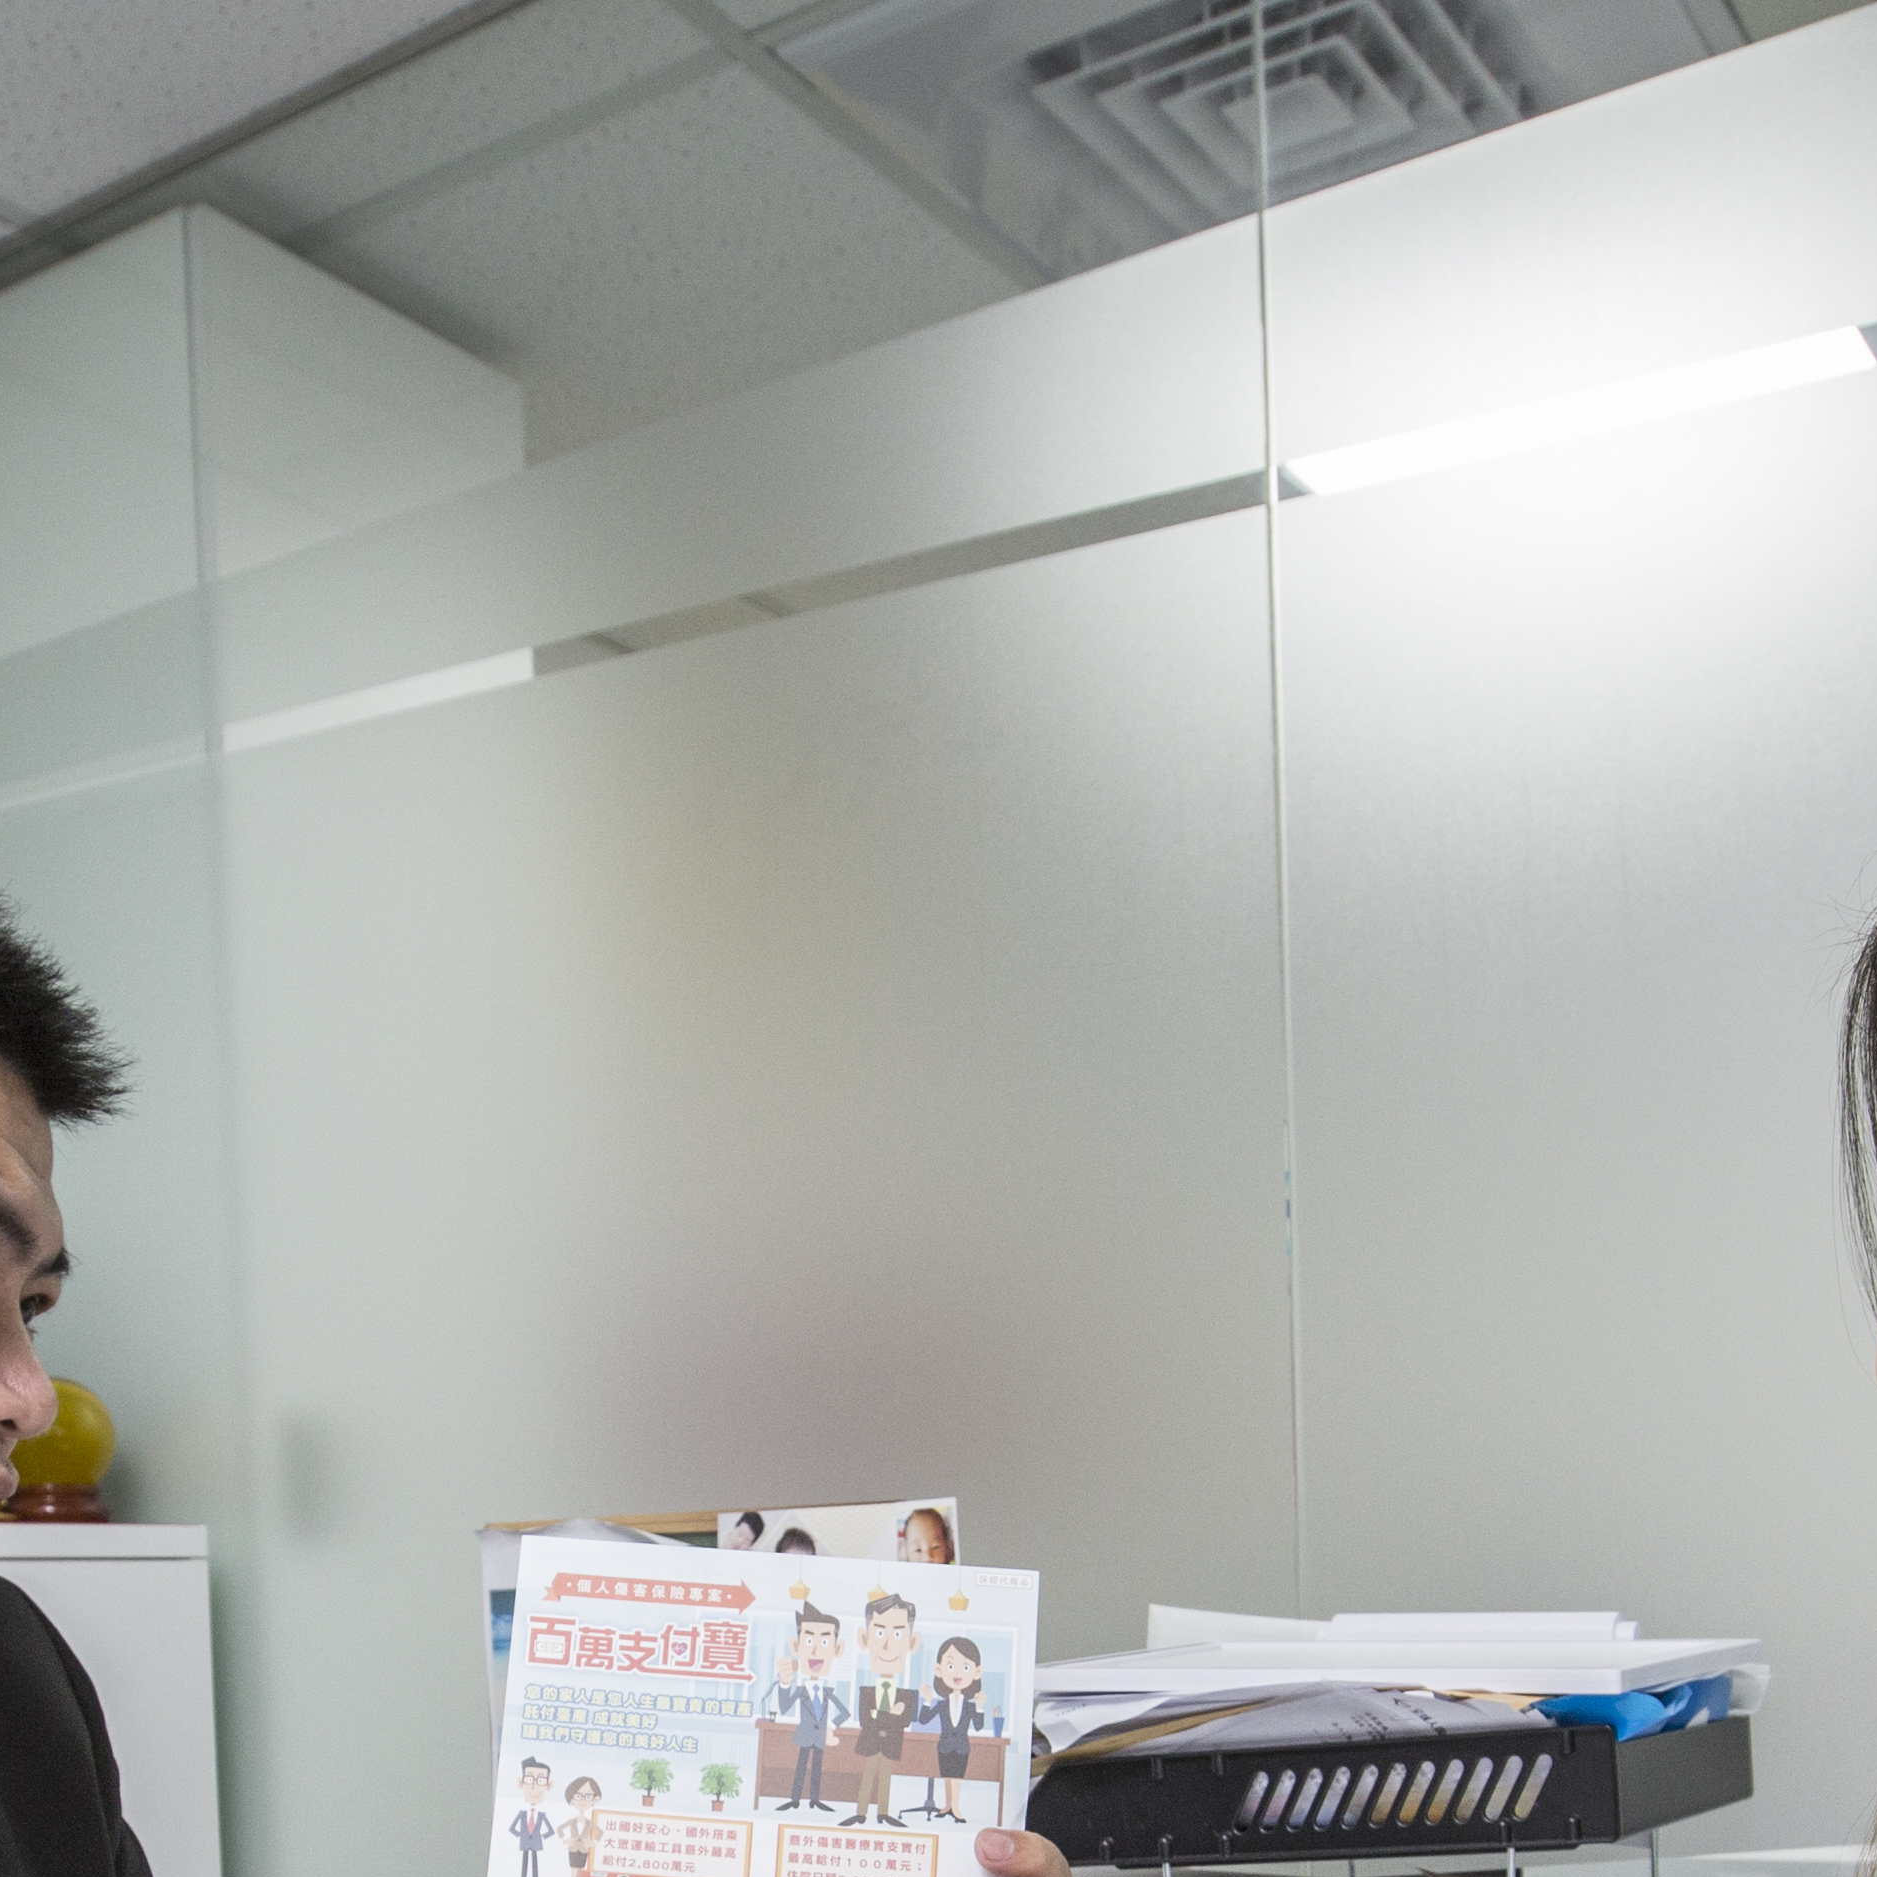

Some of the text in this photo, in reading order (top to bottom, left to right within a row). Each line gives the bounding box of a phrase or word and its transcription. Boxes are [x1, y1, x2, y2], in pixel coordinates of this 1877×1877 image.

[576, 1579, 723, 1603] 個人傷害保險專案
[527, 1615, 749, 1673] 百萬支付寶
[525, 1683, 753, 1717] 您的家人是您人生最寶貴的資產
[593, 1711, 658, 1730] 成就美好
[521, 1723, 698, 1753] 讓我們守護您的美好人生
[604, 1838, 736, 1859] 大眾運輸工具意外最高
[788, 1834, 926, 1855] 意外傷害醫療實支實付
[602, 1855, 696, 1873] 給付2,800萬元
